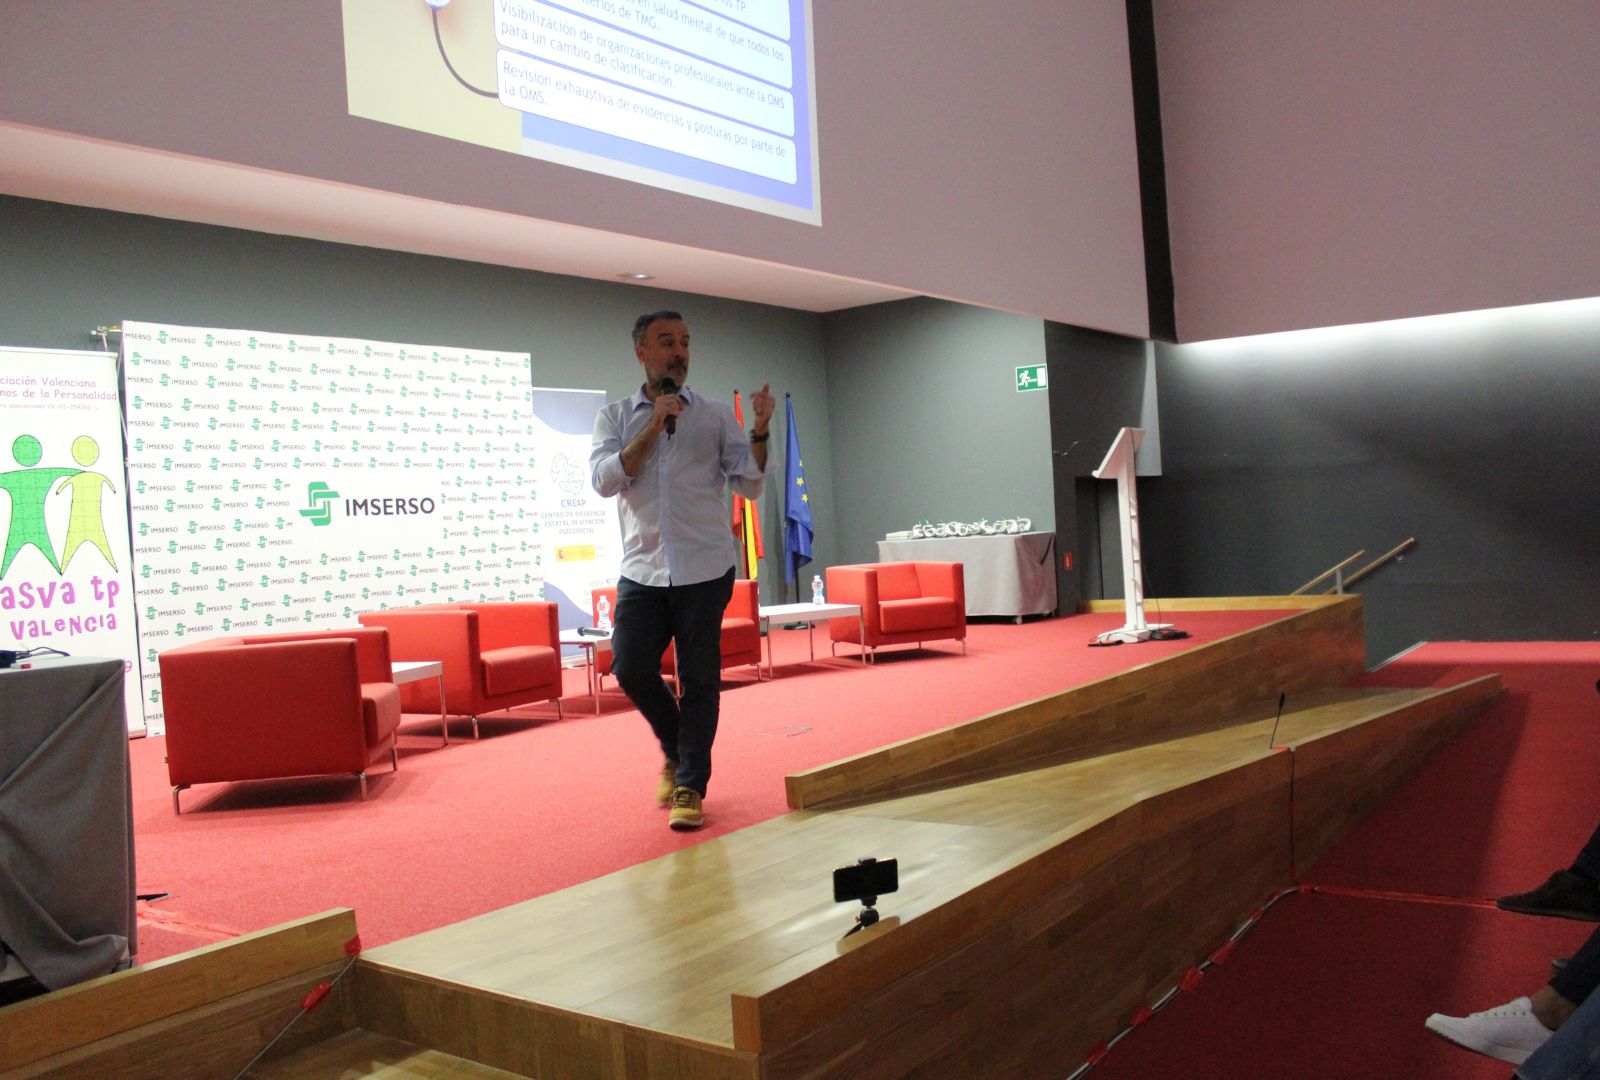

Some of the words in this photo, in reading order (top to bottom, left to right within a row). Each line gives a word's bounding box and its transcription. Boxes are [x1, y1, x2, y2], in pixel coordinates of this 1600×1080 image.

[619, 5, 631, 19] de
[634, 9, 660, 31] TMG.
[652, 2, 678, 20] salud
[681, 13, 712, 33] mental
[716, 26, 727, 39] de
[729, 33, 745, 46] que
[748, 39, 770, 56] todos
[772, 48, 784, 61] los
[500, 1, 577, 37] Visibilización
[580, 28, 593, 41] de
[597, 36, 671, 70] organizaciones
[674, 62, 734, 92] profesionales
[736, 84, 755, 99] ante
[758, 90, 766, 102] la
[768, 93, 785, 109] OMS
[501, 22, 528, 40] para
[532, 32, 546, 46] un
[550, 38, 591, 60] cambio
[594, 51, 607, 66] de
[610, 56, 676, 89] clasificación.
[504, 79, 515, 96] la
[520, 85, 549, 106] OMS.
[555, 78, 613, 105] exhaustiva
[617, 96, 630, 111] de
[633, 103, 684, 127] evidencias
[695, 121, 732, 142] posturas
[734, 133, 748, 146] por
[751, 139, 775, 154] parte
[775, 145, 786, 157] de
[22, 389, 36, 398] de
[41, 389, 50, 398] la
[54, 389, 117, 400] Personalidad
[41, 376, 97, 388] Valenciana
[345, 497, 435, 516] IMSERSO
[560, 499, 586, 507] CREAP
